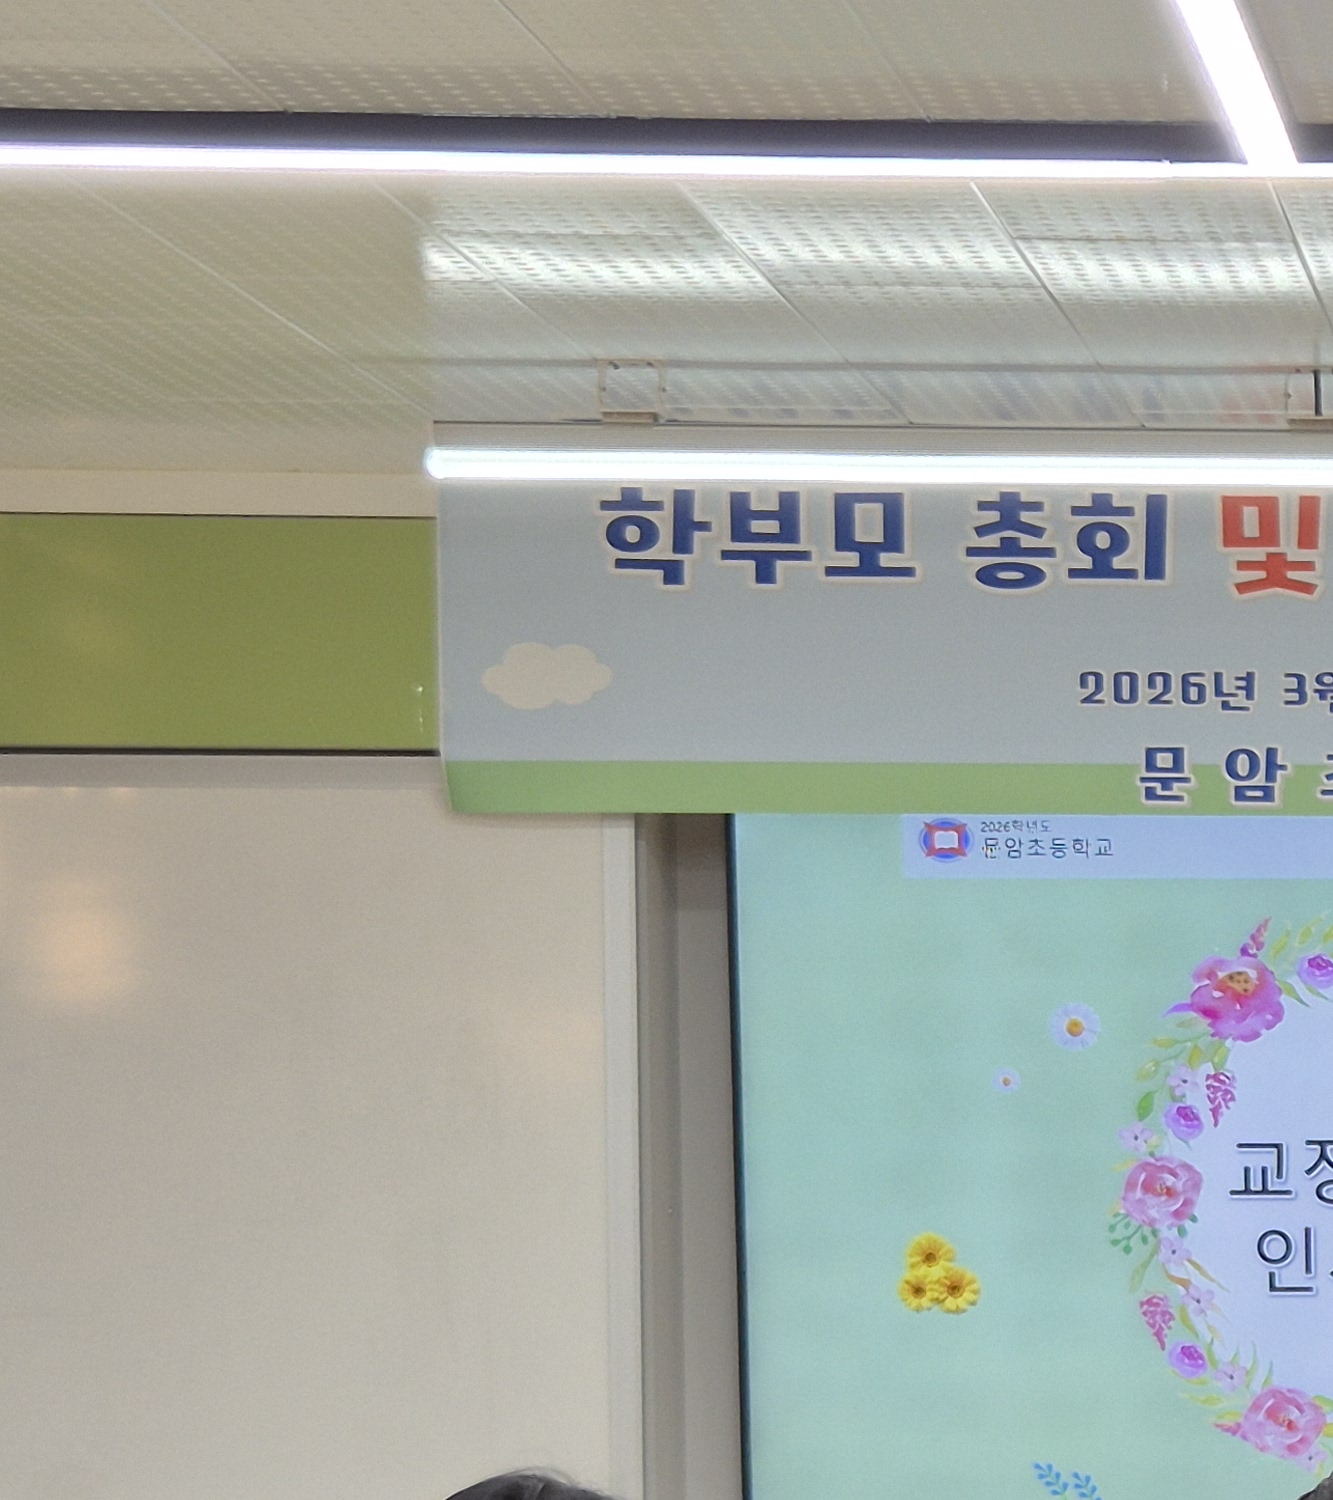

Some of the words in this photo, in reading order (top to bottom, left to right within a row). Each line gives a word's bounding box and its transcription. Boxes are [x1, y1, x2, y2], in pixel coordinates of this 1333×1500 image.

[599, 485, 917, 588] 학부모
[965, 490, 1167, 590] 총회
[1219, 494, 1322, 598] 및
[1078, 670, 1257, 712] 2026년
[983, 837, 1114, 859] 문암초등학교
